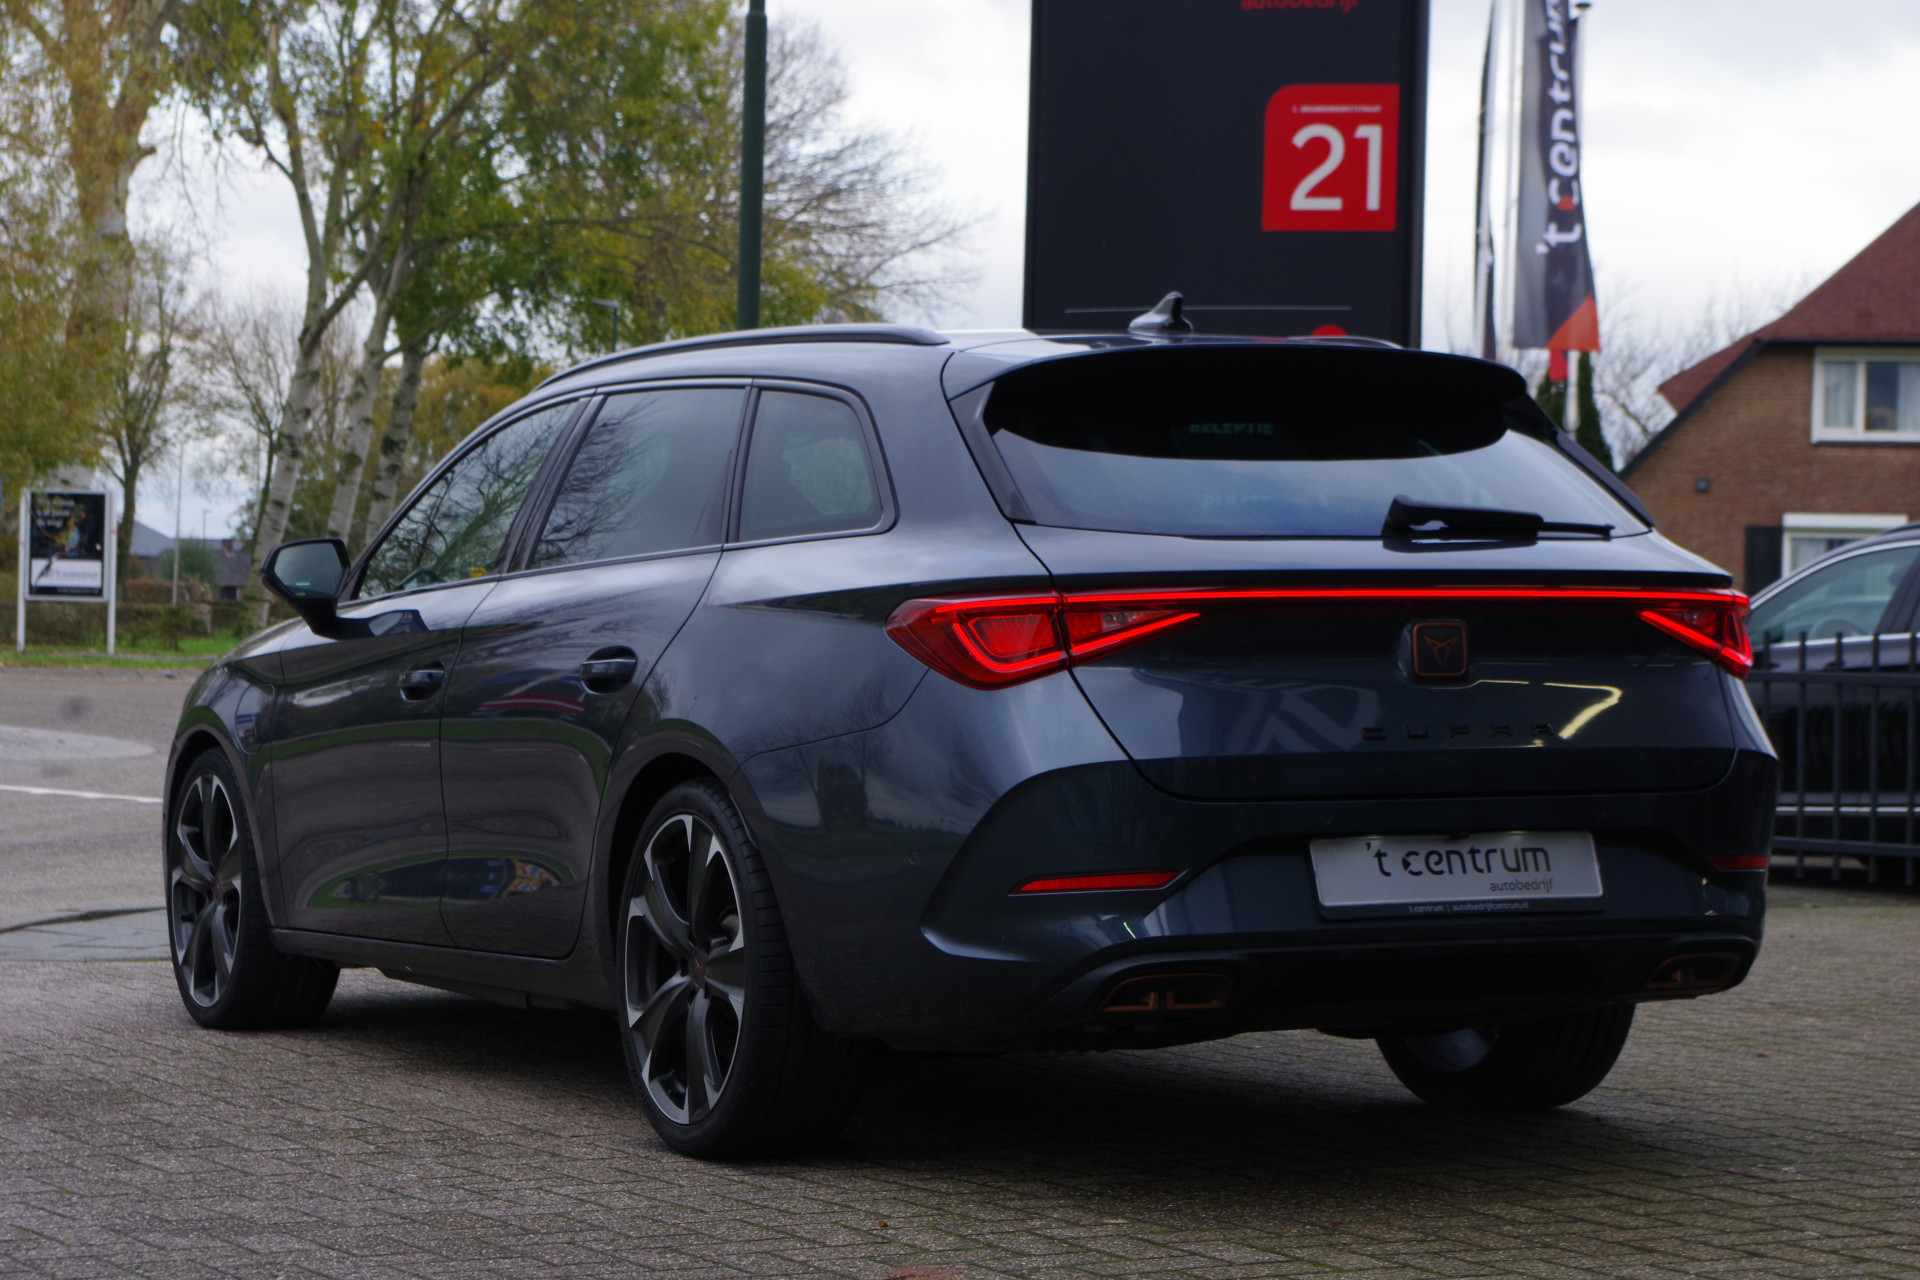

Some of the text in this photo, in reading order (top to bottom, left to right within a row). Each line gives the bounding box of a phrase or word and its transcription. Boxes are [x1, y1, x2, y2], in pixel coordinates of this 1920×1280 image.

[1290, 124, 1383, 211] 21
[1365, 842, 1551, 877] 't centrum
[1489, 877, 1553, 894] autobedrijf
